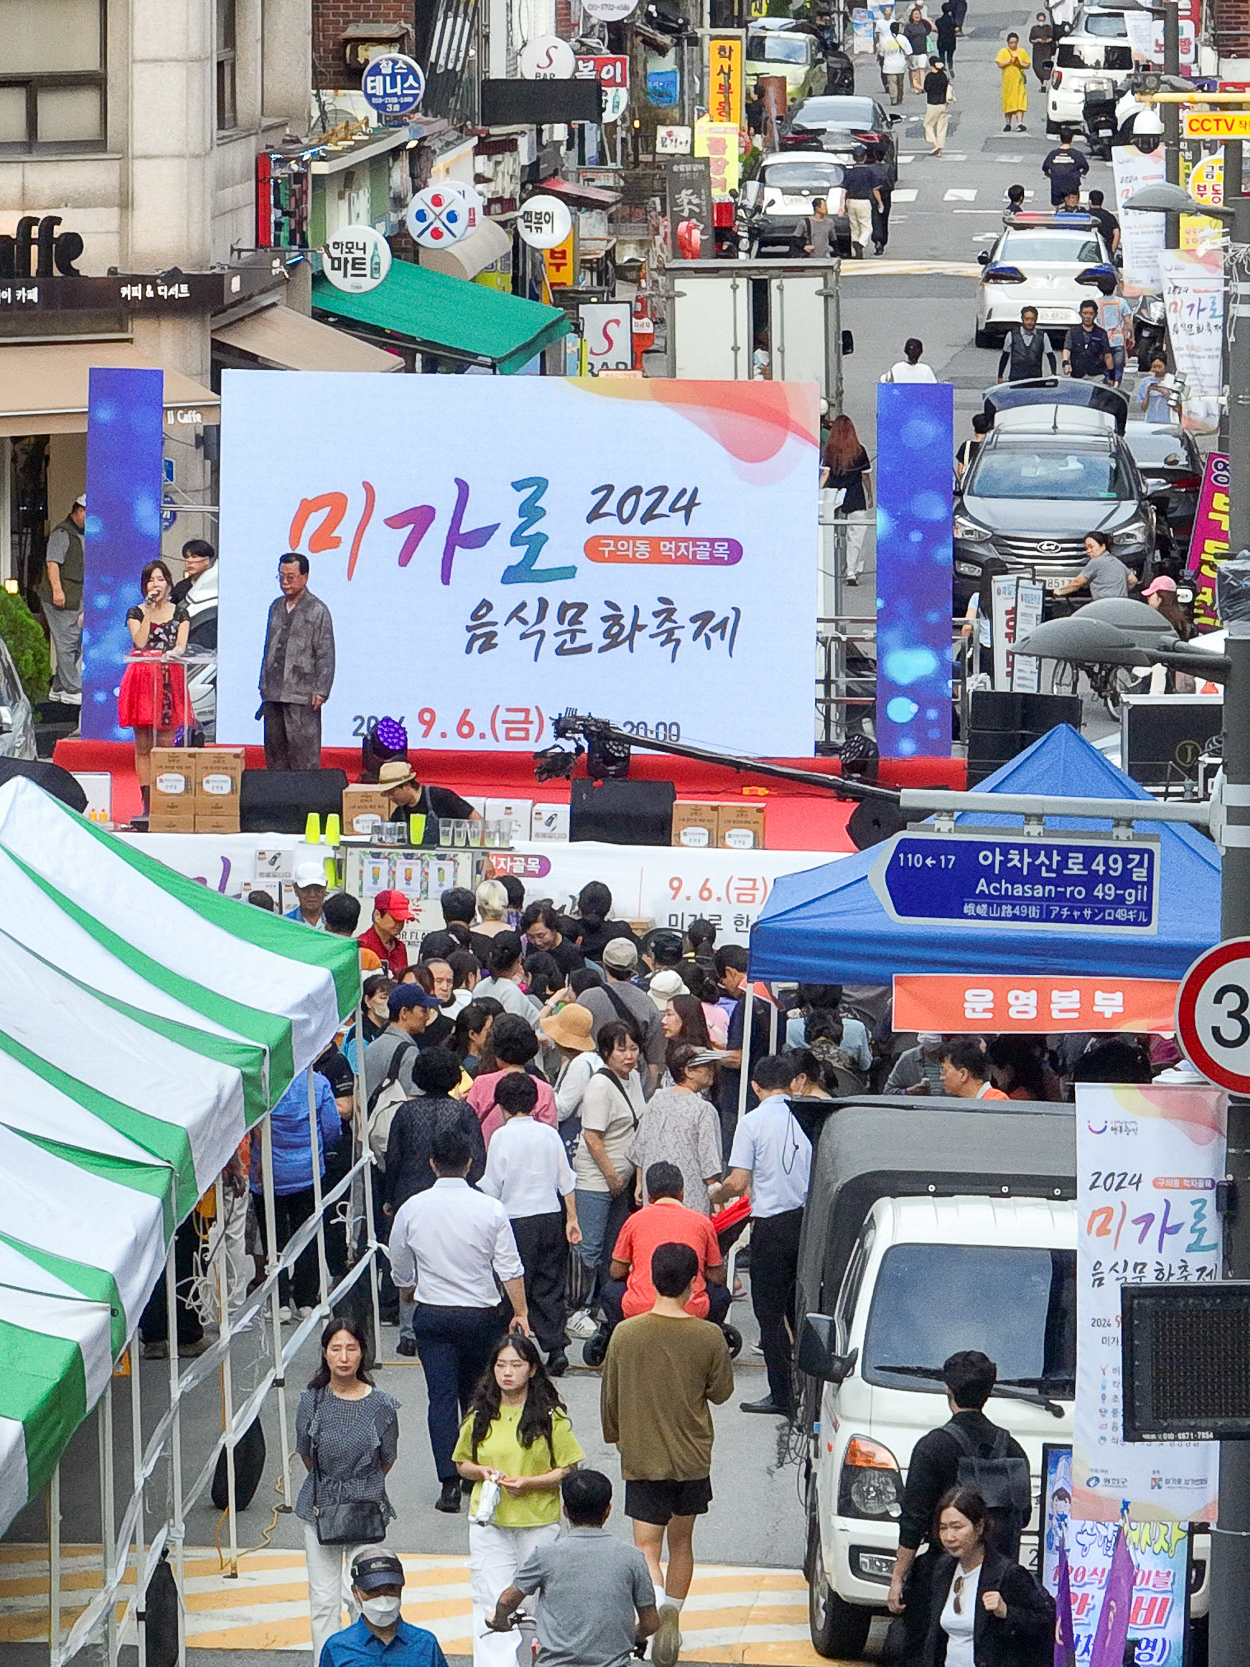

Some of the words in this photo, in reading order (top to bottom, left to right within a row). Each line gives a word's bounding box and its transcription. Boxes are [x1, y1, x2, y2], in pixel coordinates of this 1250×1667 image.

[536, 44, 559, 70] S
[366, 75, 420, 96] 테니스
[1188, 119, 1235, 132] CCTV
[332, 241, 367, 255] 하모니
[329, 254, 368, 279] 마트
[15, 287, 40, 304] 카페
[120, 284, 144, 301] 커피
[145, 284, 155, 298] &
[1168, 296, 1224, 322] 미가로
[589, 318, 622, 357] S
[176, 410, 203, 424] Caffe
[287, 475, 579, 586] 미가로
[585, 482, 702, 527] 2024
[597, 538, 651, 561] 구의동
[658, 538, 731, 561] 먹자골목
[464, 596, 742, 663] 음식문화축제
[898, 853, 923, 868] 110
[940, 855, 956, 870] 17
[978, 847, 1150, 882] 아차산로49길
[975, 877, 1086, 900] Achasan-ro
[1092, 883, 1148, 905] 49-gil
[963, 902, 1040, 919] 峨嵯山路49街
[963, 987, 1125, 1020] 운영본부
[1089, 1171, 1143, 1192] 2024
[1087, 1197, 1220, 1254] 미가로
[1090, 1258, 1218, 1288] 음식문화축제
[1090, 1317, 1112, 1328] 2024
